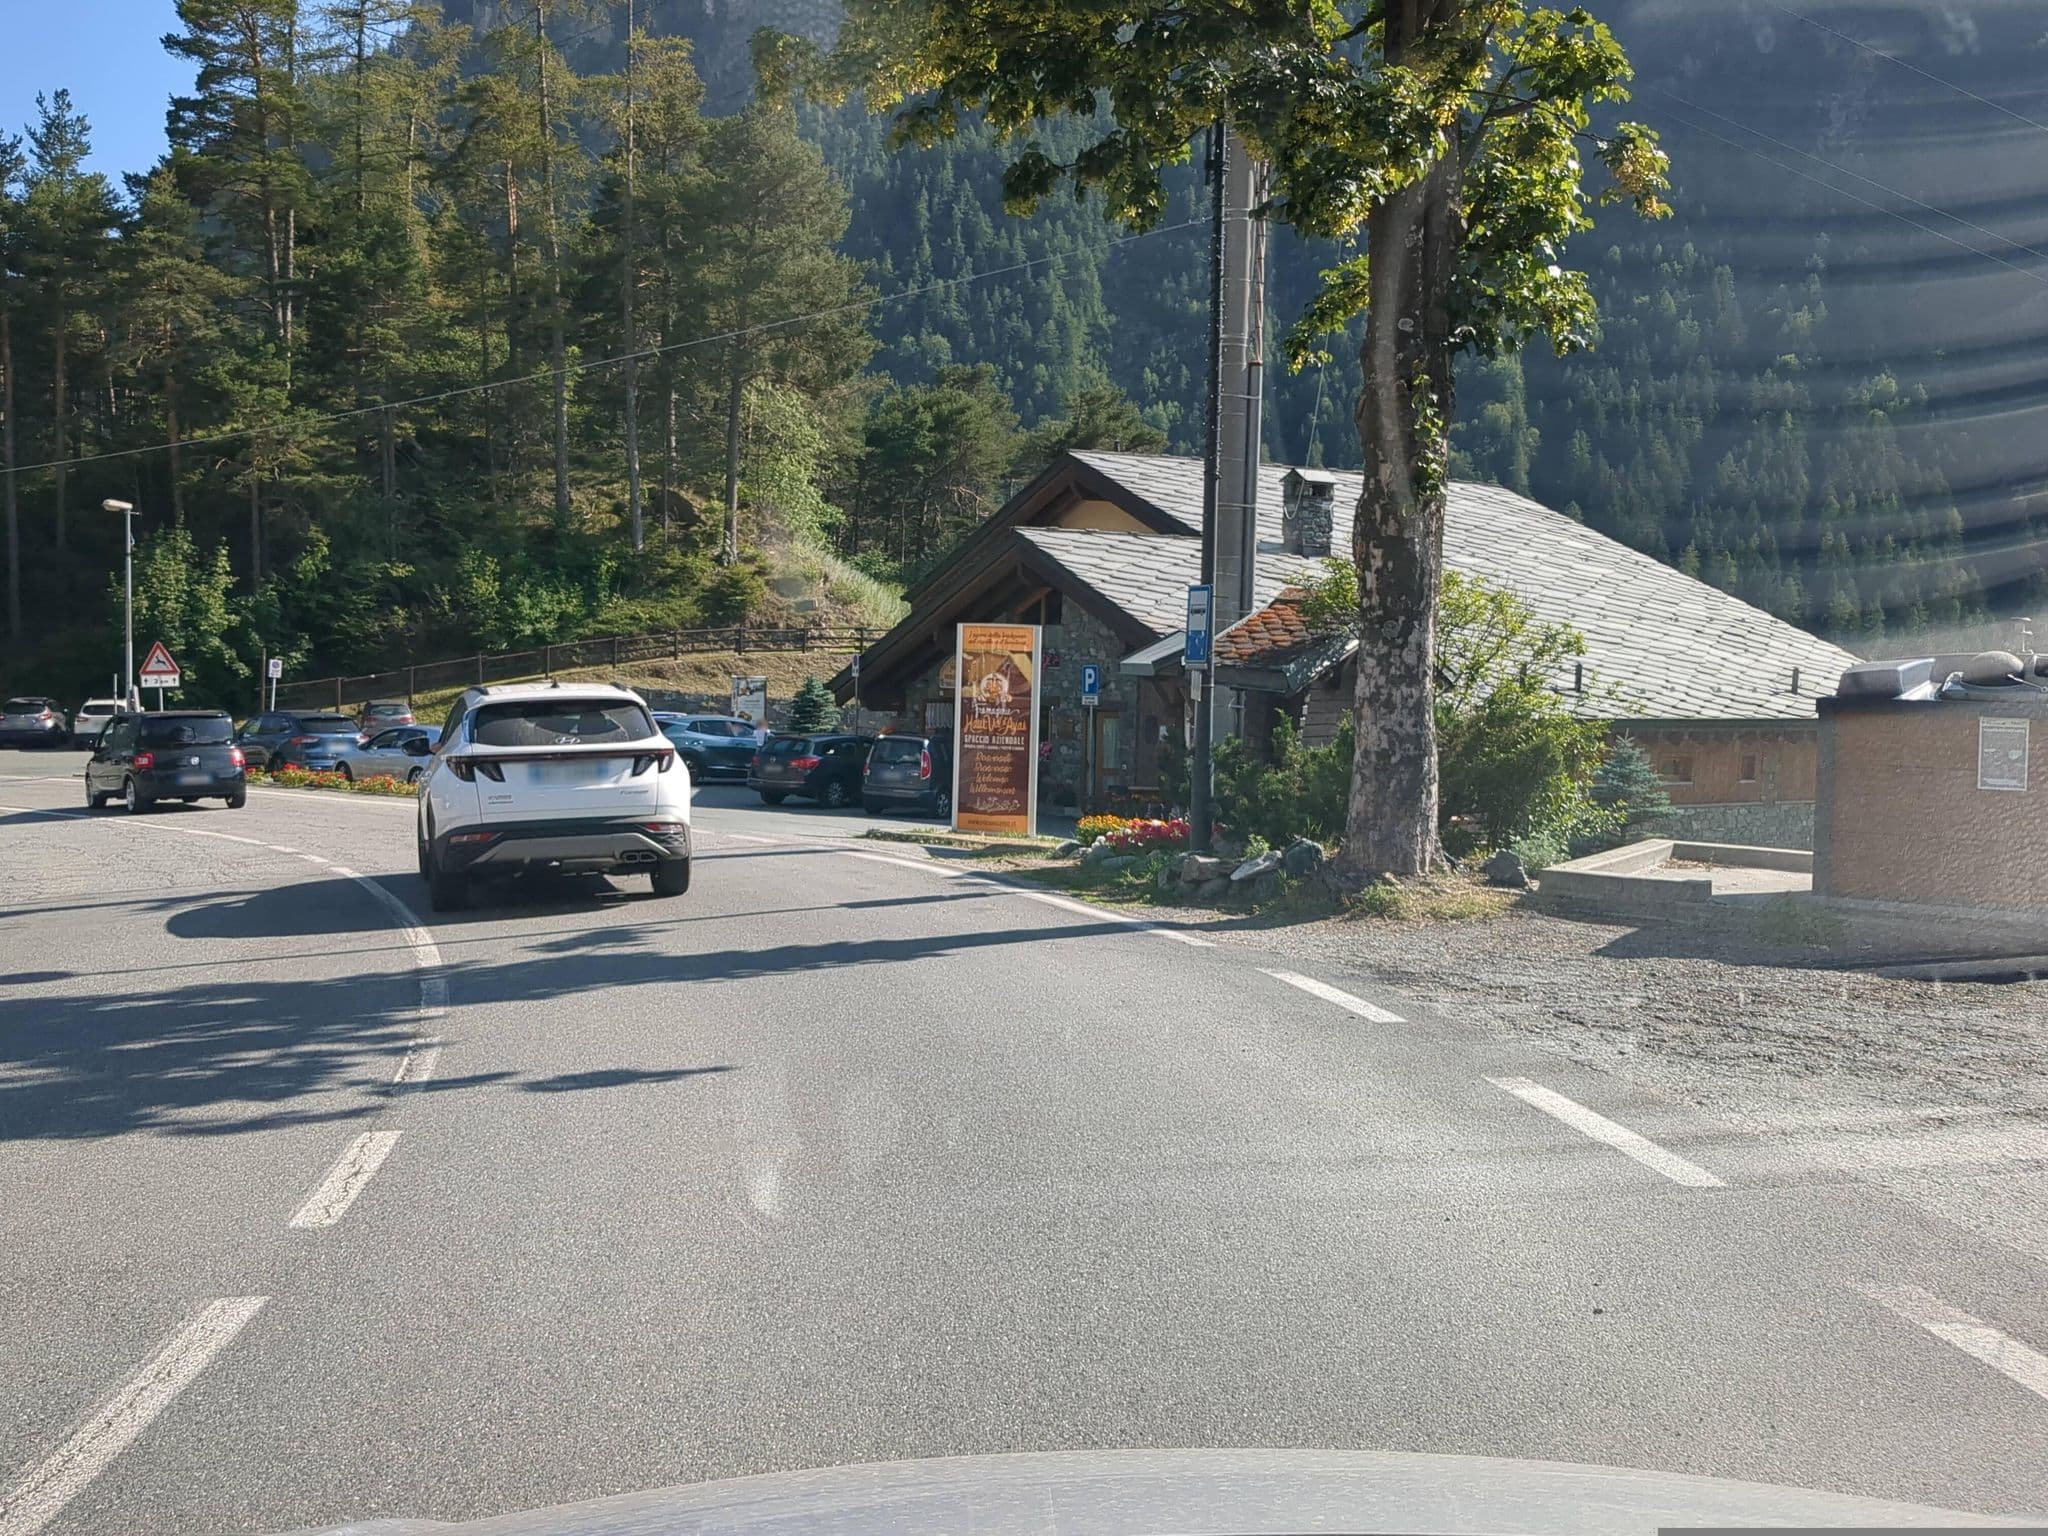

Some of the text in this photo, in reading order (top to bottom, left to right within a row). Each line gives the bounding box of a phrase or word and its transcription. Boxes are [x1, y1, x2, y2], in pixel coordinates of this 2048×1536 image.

[1085, 668, 1096, 692] P
[964, 735, 1025, 745] SPACCIO AZIENDALE
